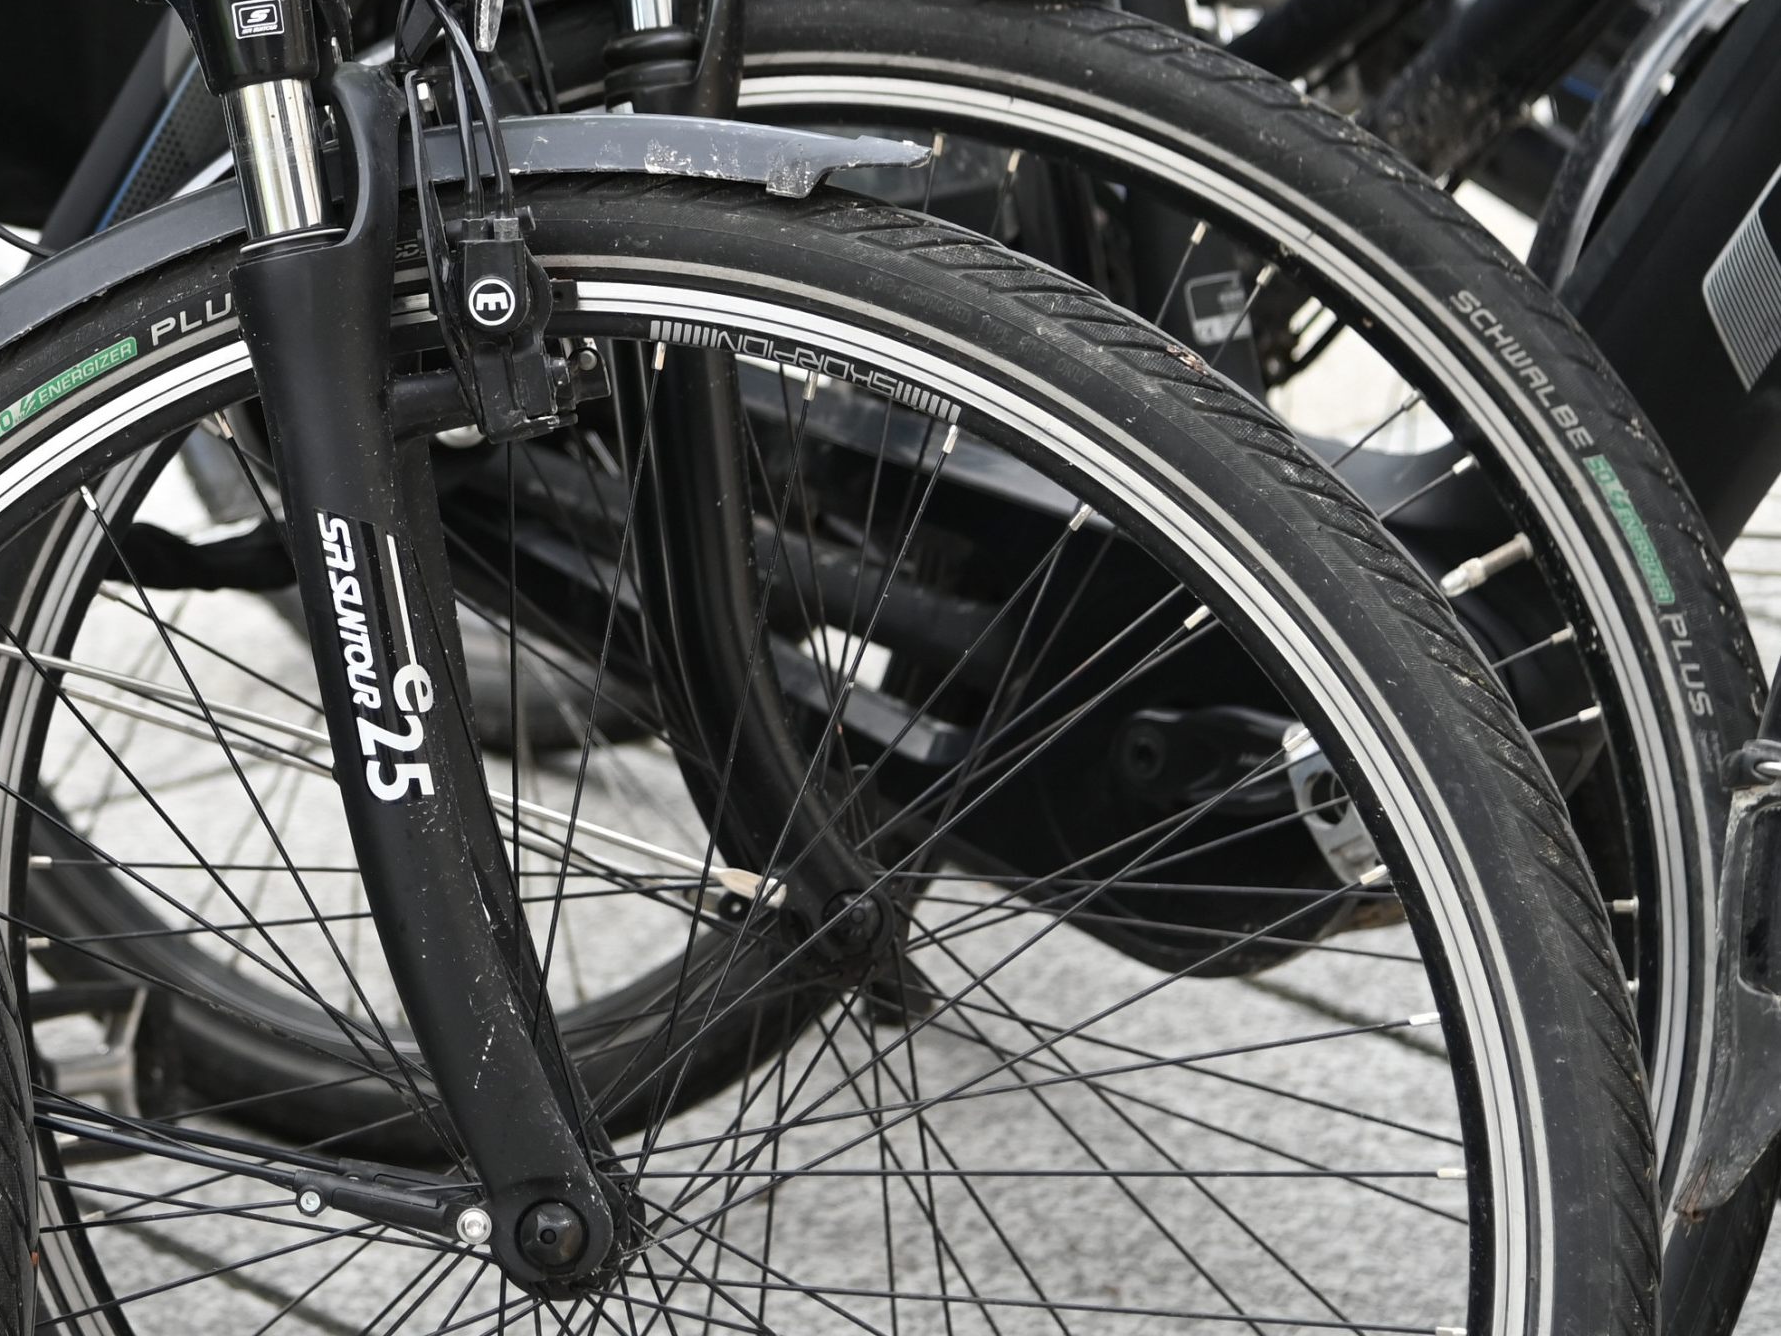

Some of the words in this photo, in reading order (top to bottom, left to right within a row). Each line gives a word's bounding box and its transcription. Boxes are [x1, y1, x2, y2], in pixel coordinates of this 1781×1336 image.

[38, 341, 134, 405] ENERGIZER
[150, 291, 232, 347] PLU
[317, 512, 356, 572] SR
[1450, 290, 1594, 450] SCHWALBE
[1660, 613, 1715, 718] PLUS
[328, 569, 382, 710] SUNTOUR
